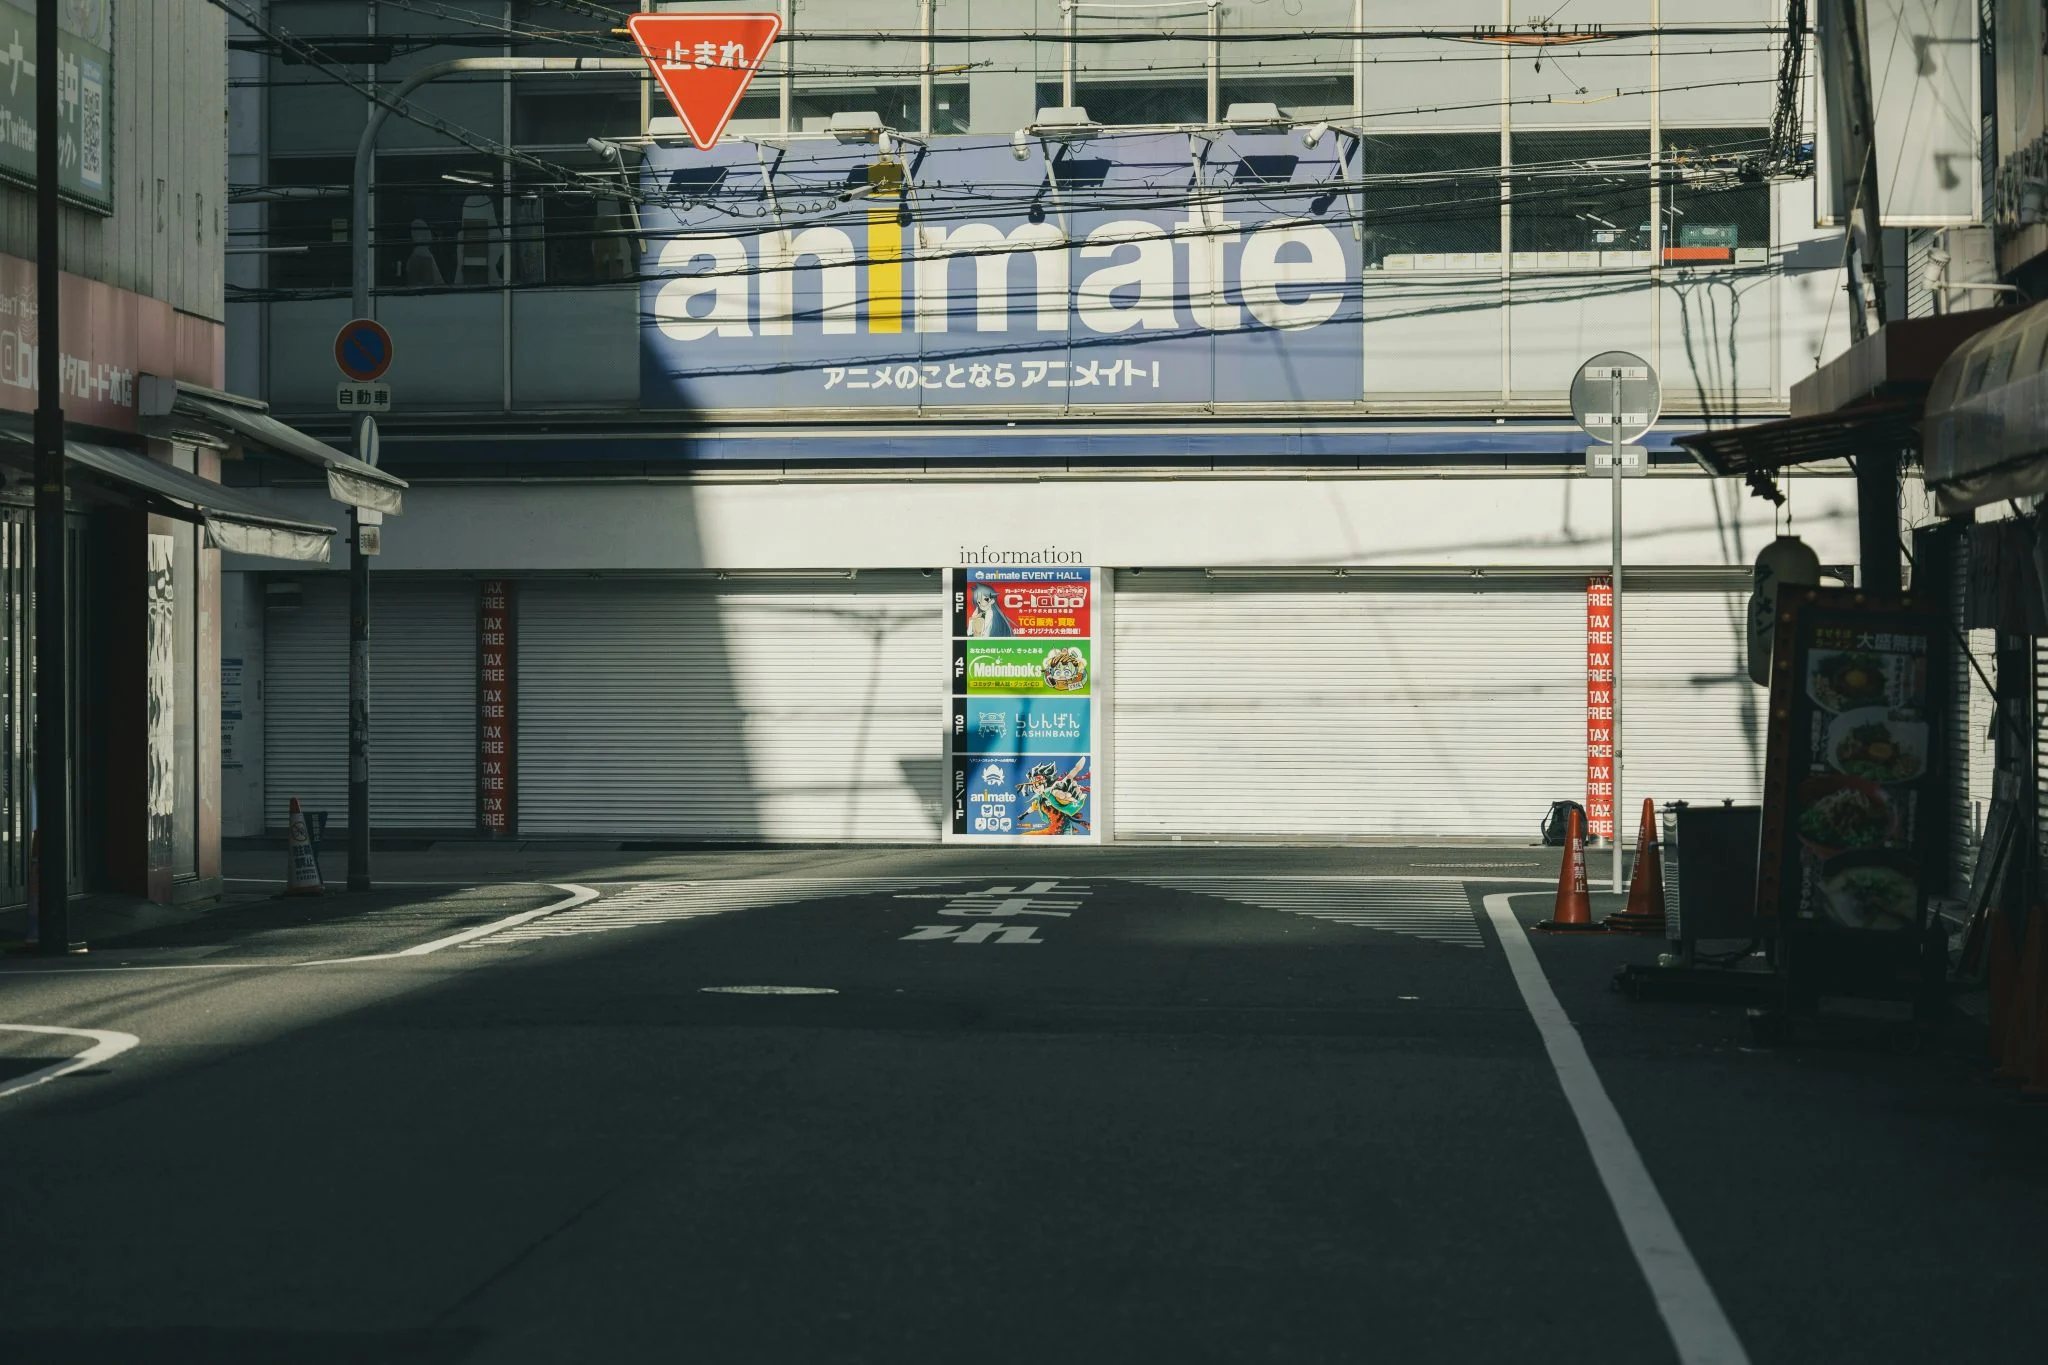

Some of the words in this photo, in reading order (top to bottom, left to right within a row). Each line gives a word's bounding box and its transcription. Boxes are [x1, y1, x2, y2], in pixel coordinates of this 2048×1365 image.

[661, 40, 749, 71] 止まれ
[654, 163, 1346, 341] animate
[340, 389, 388, 405] 自動車
[960, 545, 1083, 565] information
[985, 571, 1020, 580] animate
[1022, 572, 1054, 580] EVENT
[1057, 572, 1083, 580] HALL
[1590, 578, 1610, 590] TAX
[1588, 593, 1612, 606] FREE
[483, 618, 502, 630] TAX
[1018, 617, 1035, 626] TCG
[1590, 615, 1610, 628] TAX
[1588, 631, 1612, 644] FREE
[483, 654, 502, 666] TAX
[1590, 653, 1610, 665] TAX
[974, 661, 1042, 678] Melonbooks
[1588, 669, 1612, 682] FREE
[483, 690, 502, 702] TAX
[1590, 691, 1610, 703] TAX
[1588, 707, 1612, 720] FREE
[1016, 713, 1080, 729] らしんばん
[483, 726, 502, 738] TAX
[1016, 730, 1080, 738] LASHINBANG
[1590, 729, 1610, 741] TAX
[1588, 745, 1612, 757] FREE
[483, 762, 502, 774] TAX
[1590, 766, 1610, 779] TAX
[1588, 782, 1612, 795] FREE
[971, 789, 1016, 802] animate
[483, 798, 502, 810] TAX
[1590, 804, 1610, 817] TAX
[1588, 820, 1612, 833] FREE
[1572, 837, 1586, 893] 駐車禁止
[898, 881, 1094, 944] 止まれ
